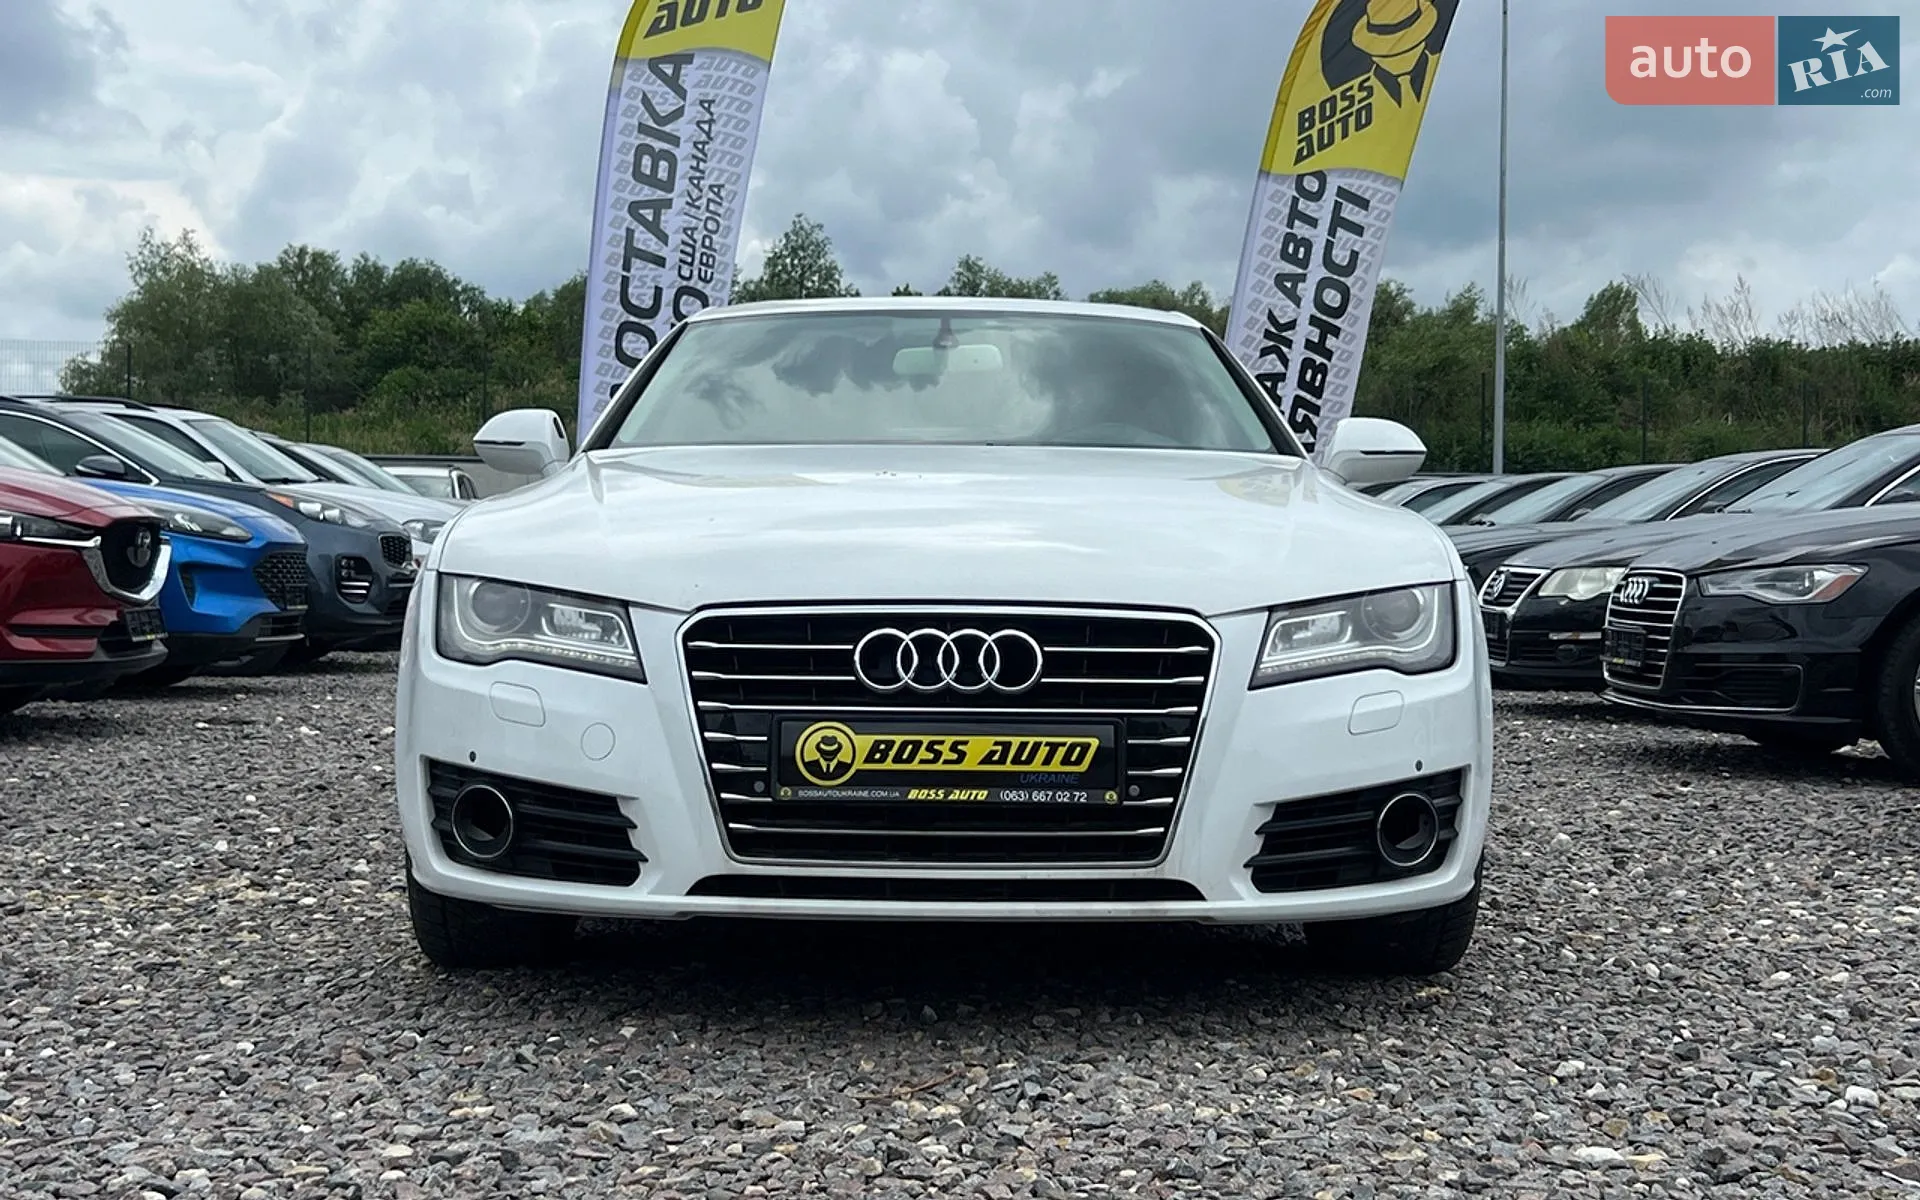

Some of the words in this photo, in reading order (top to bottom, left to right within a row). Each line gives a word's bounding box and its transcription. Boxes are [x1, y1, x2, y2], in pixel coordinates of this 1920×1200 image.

[1293, 101, 1373, 167] AUTO
[1297, 75, 1374, 136] BOSS
[685, 99, 716, 210] КАНАДА
[609, 53, 695, 399] ОСТАВКА
[677, 226, 699, 281] США
[1274, 170, 1328, 308] АВТО
[1288, 186, 1370, 453] ЯВНОСТІ
[1255, 308, 1298, 415] АЖ
[862, 739, 971, 765] BOSS
[977, 740, 1096, 766] AUTO
[1020, 773, 1080, 784] UKRAINE
[907, 788, 945, 799] BOSS
[948, 789, 989, 800] AUTO
[1000, 789, 1029, 802] (063)
[1031, 790, 1052, 802] 667
[1055, 791, 1070, 802] 02
[1073, 791, 1087, 802] 72
